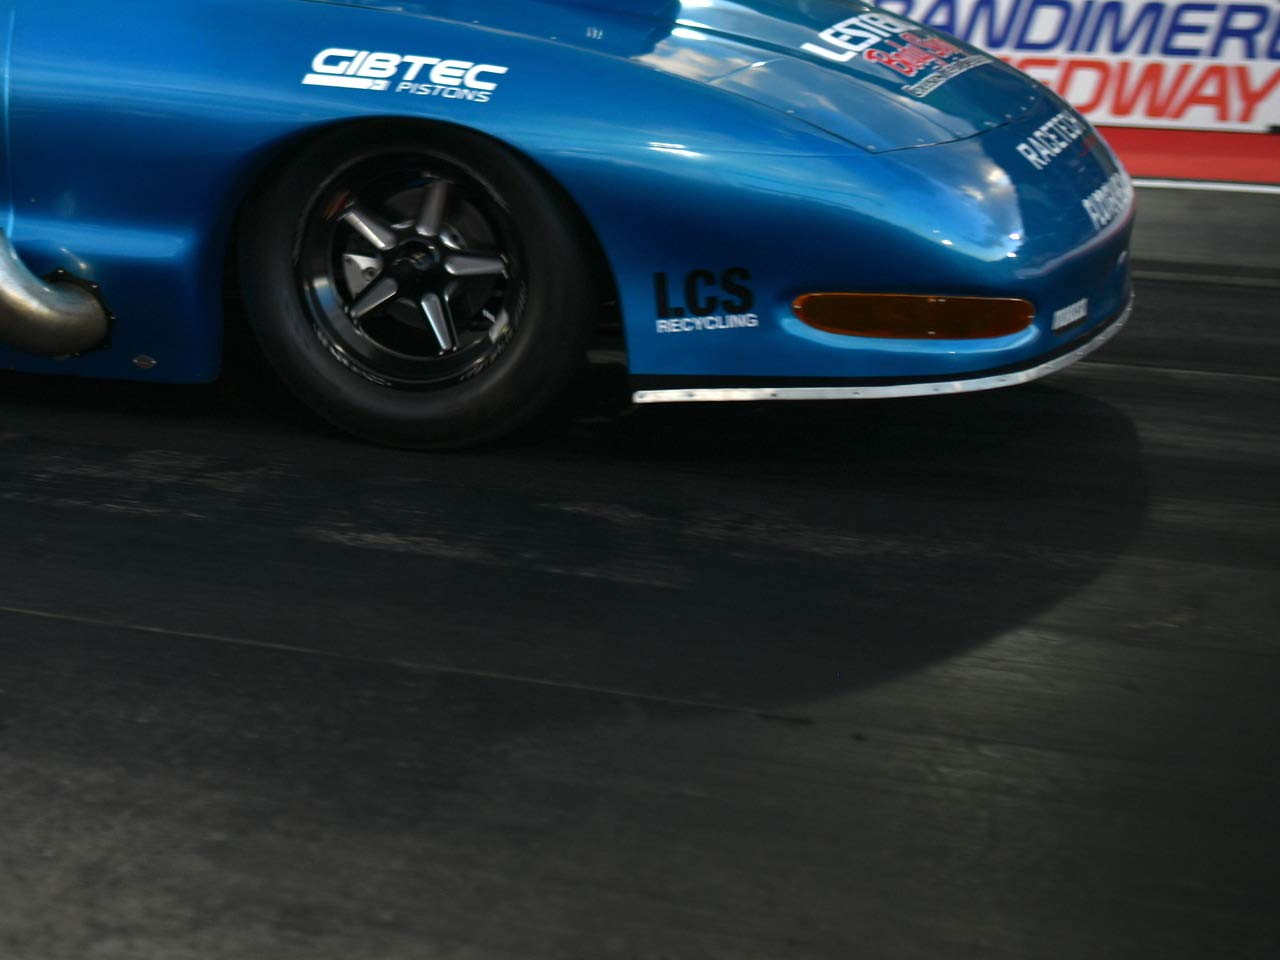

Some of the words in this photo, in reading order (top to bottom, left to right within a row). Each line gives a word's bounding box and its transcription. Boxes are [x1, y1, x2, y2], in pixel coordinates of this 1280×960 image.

[311, 48, 509, 91] GIBTEC
[395, 81, 493, 103] PISTONS
[653, 267, 754, 318] LCS
[655, 313, 759, 333] RECYCLING
